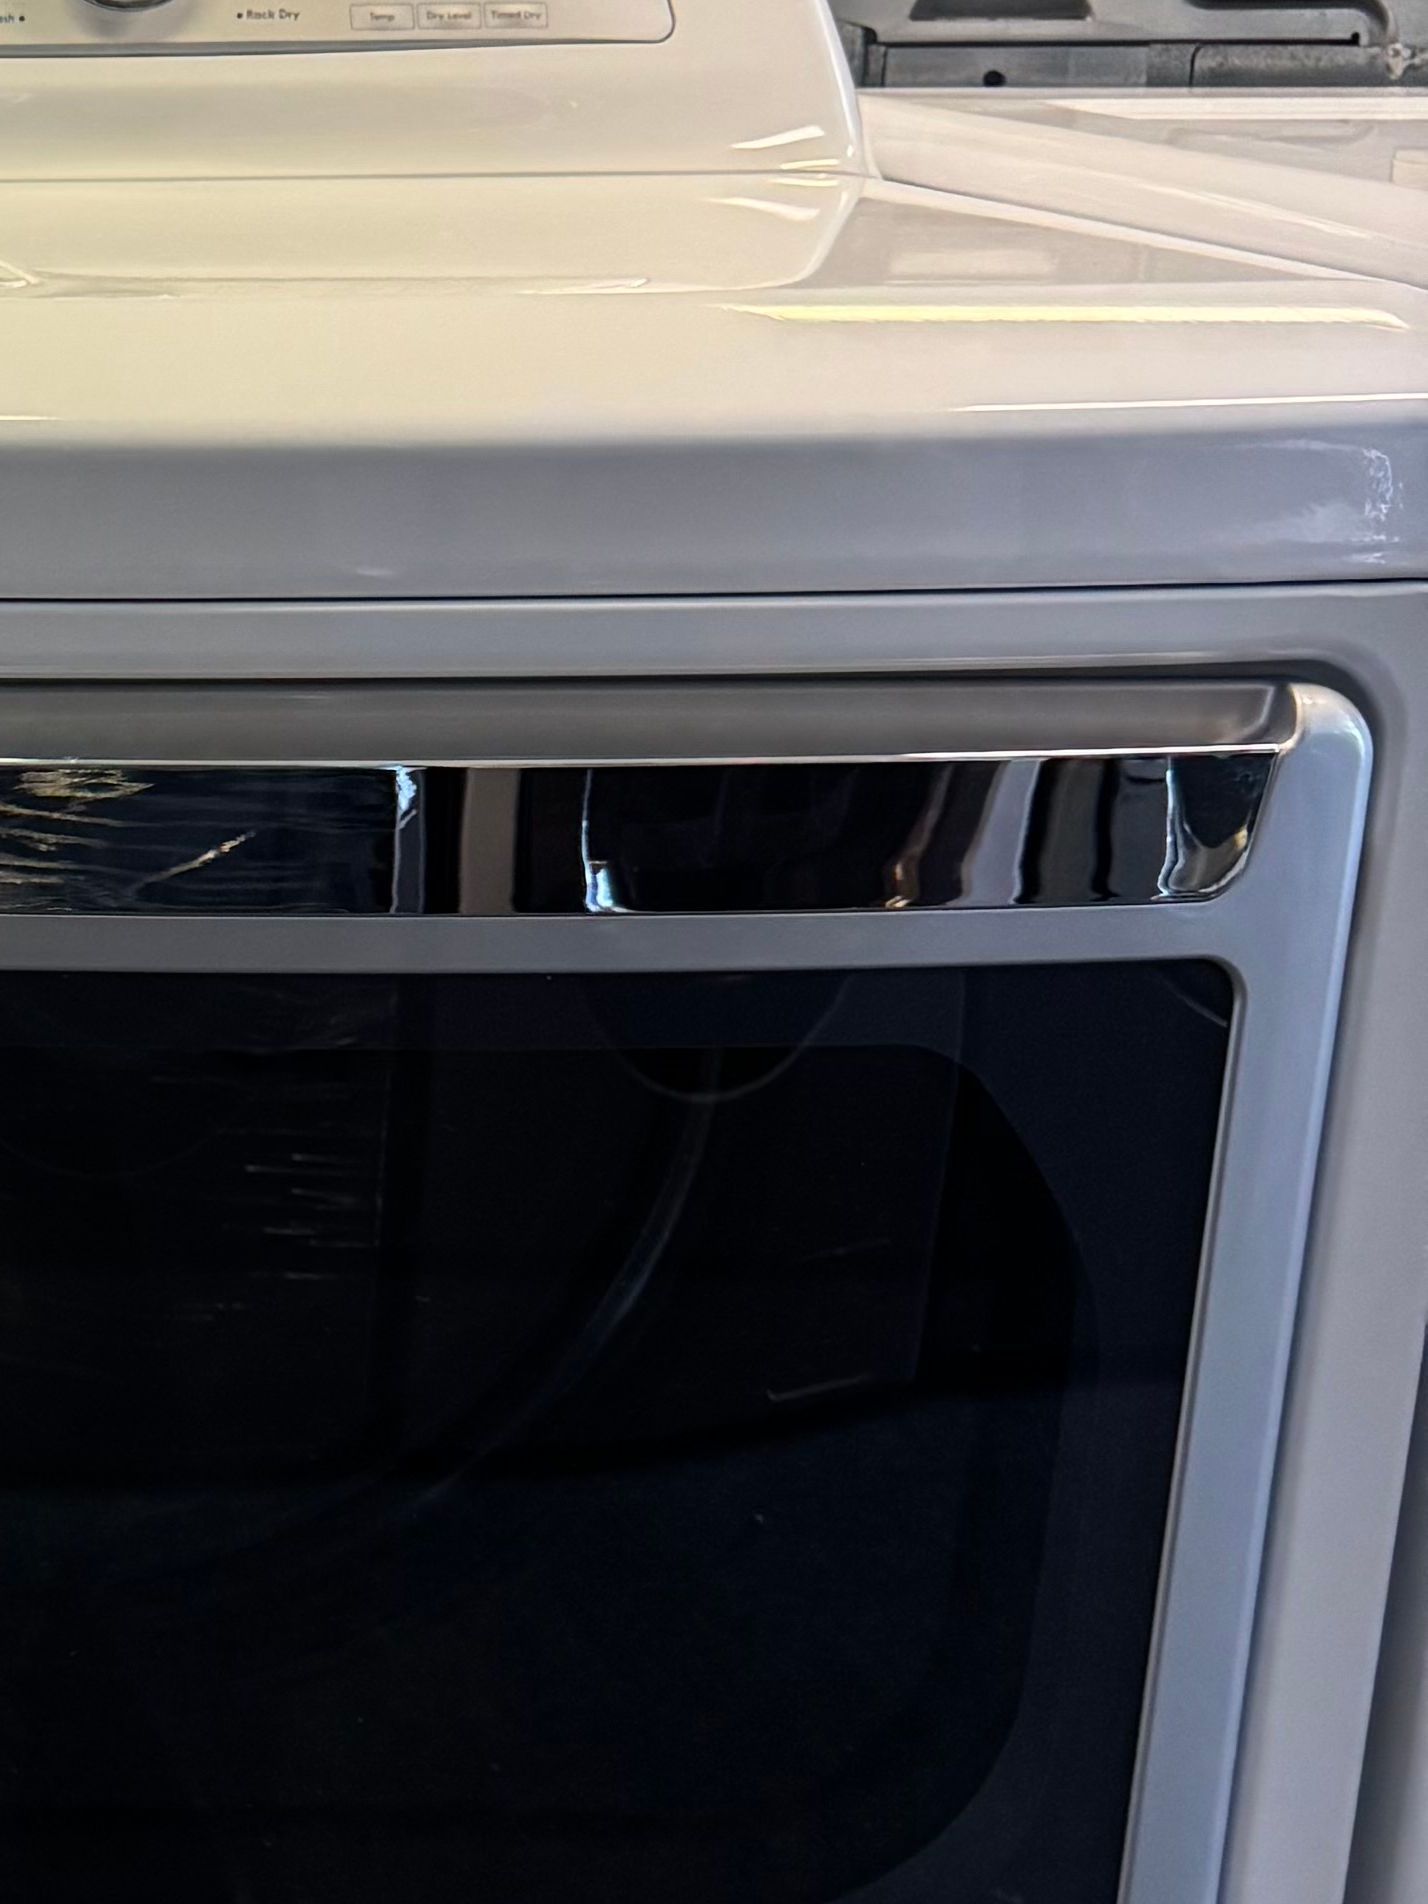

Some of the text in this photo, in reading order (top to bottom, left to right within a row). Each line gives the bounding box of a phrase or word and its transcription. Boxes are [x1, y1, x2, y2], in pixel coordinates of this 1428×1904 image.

[246, 8, 300, 21] Rack Dry
[426, 10, 445, 21] Dry
[524, 10, 541, 21] Dry
